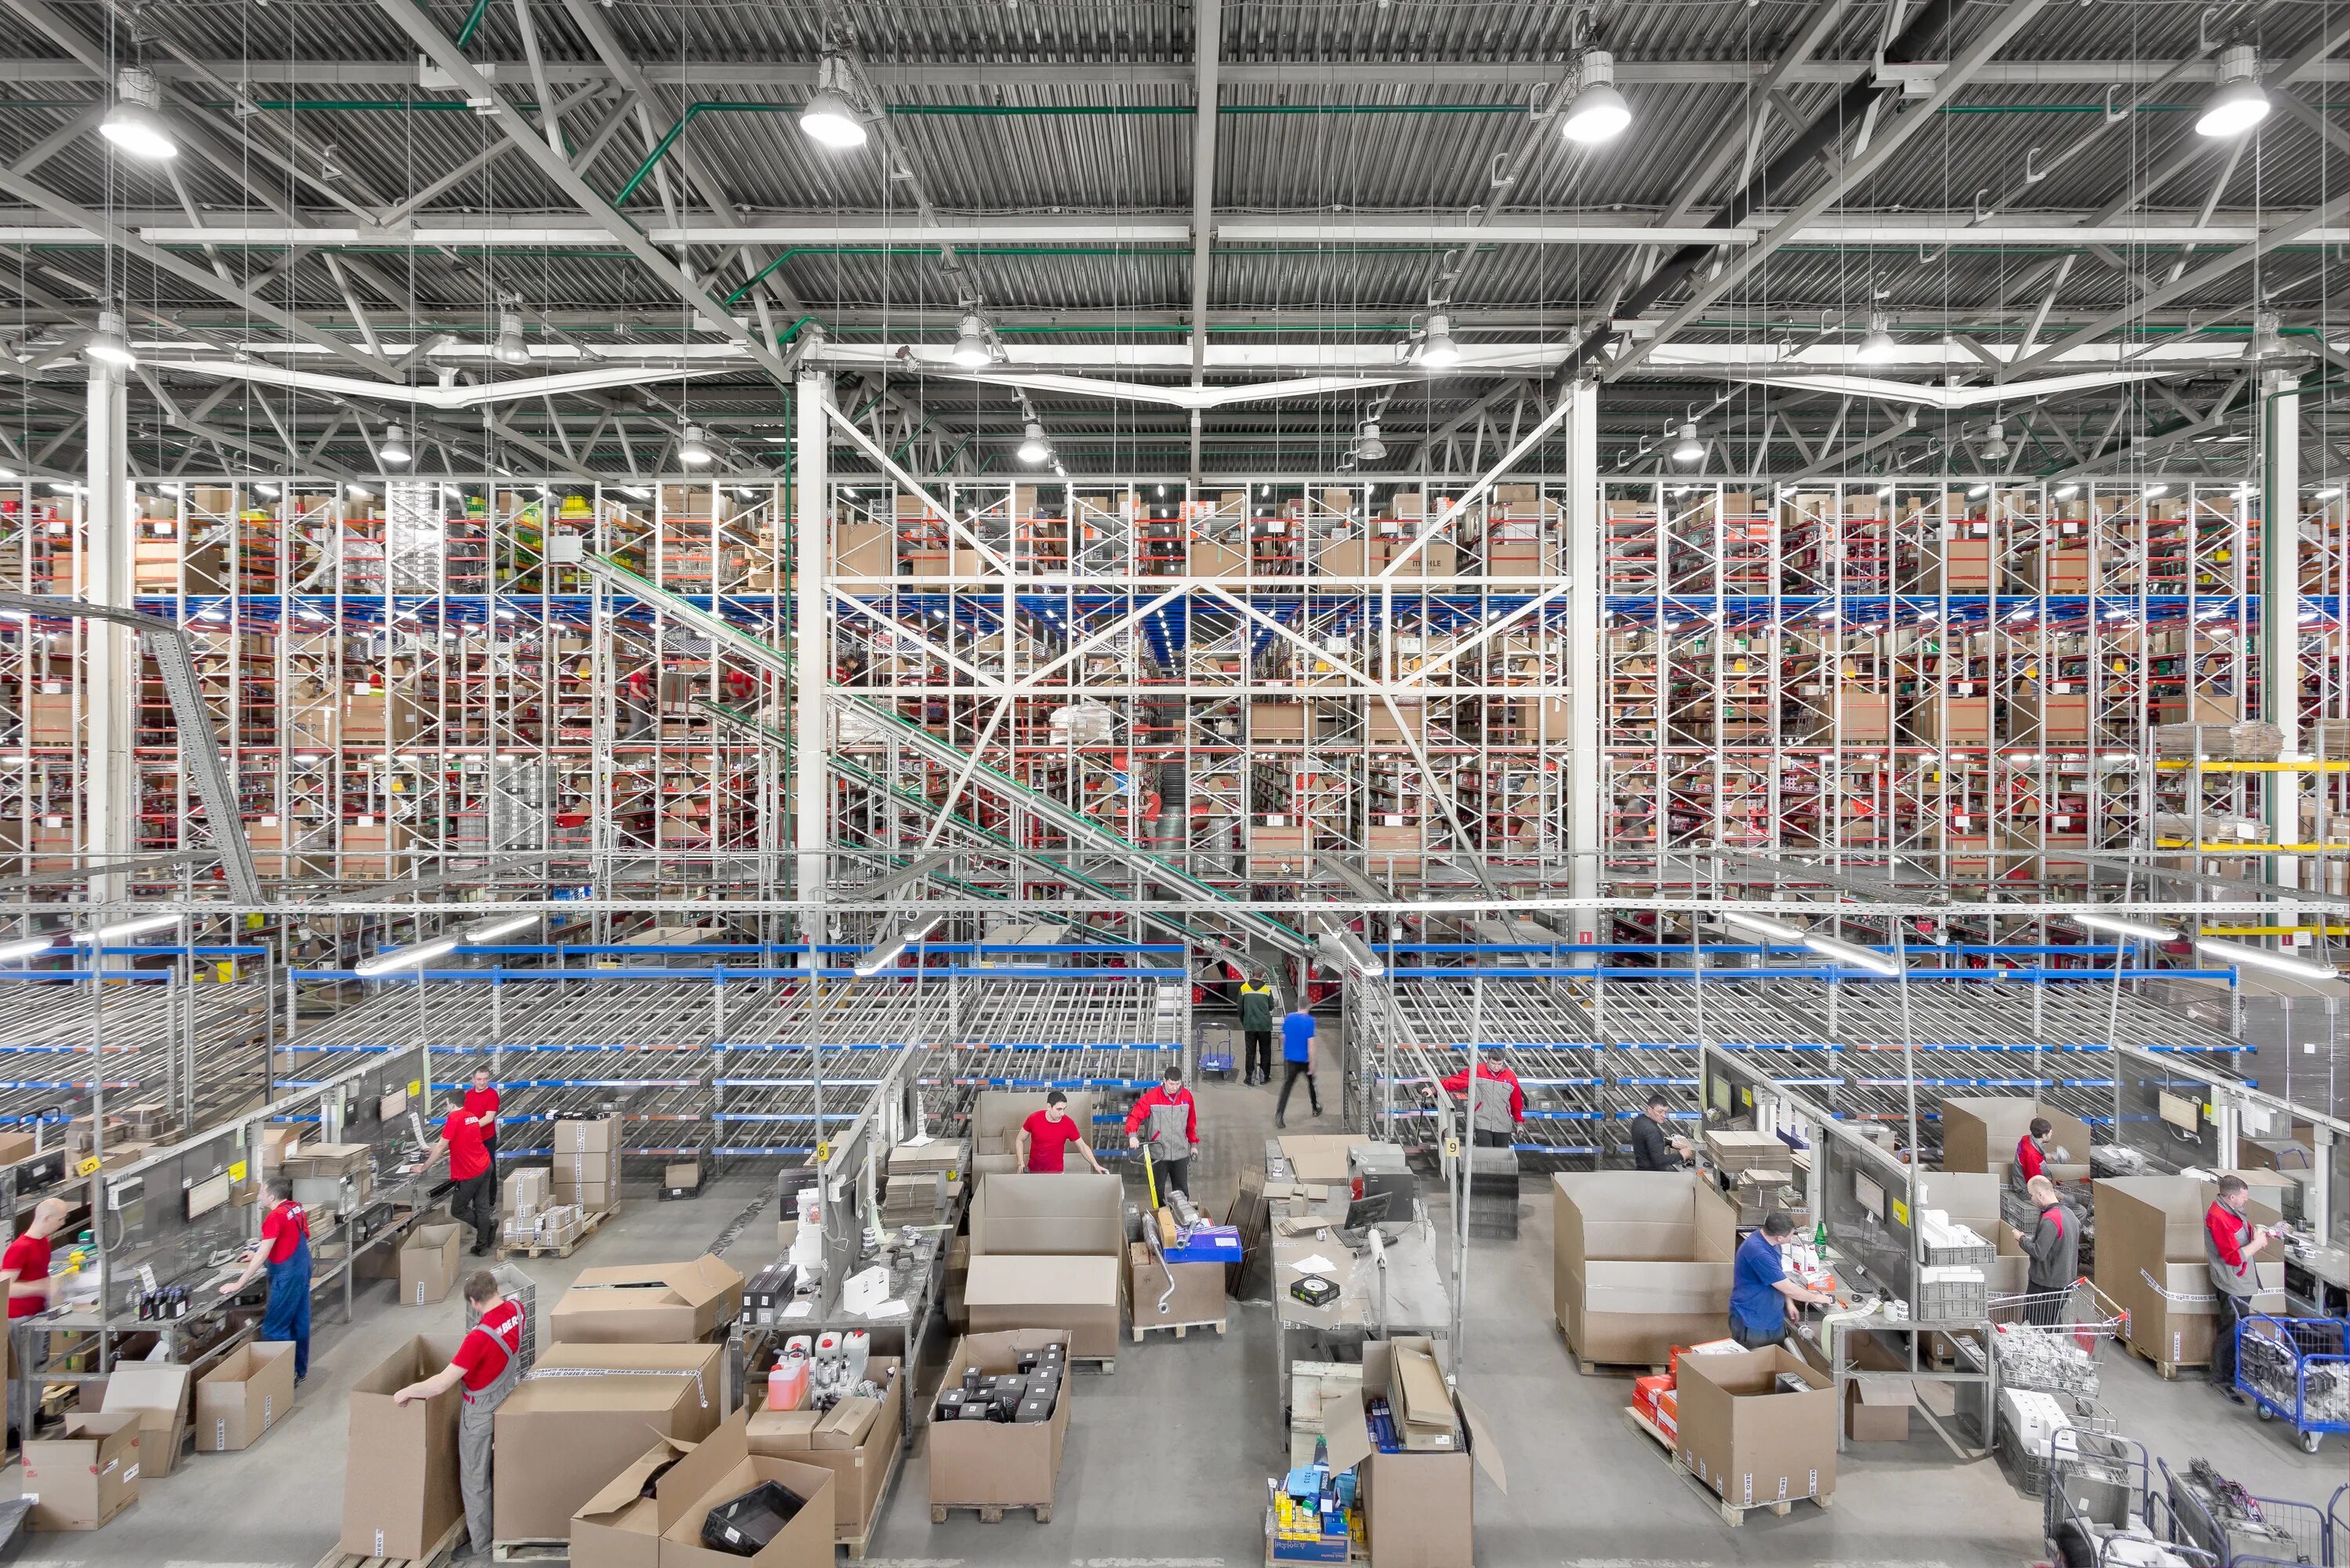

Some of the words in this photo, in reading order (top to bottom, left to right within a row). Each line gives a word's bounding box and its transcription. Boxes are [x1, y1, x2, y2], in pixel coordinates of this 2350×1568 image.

[819, 1146, 825, 1157] 6
[1450, 1143, 1457, 1152] 9
[82, 1162, 95, 1171] 5
[502, 1314, 524, 1334] BER
